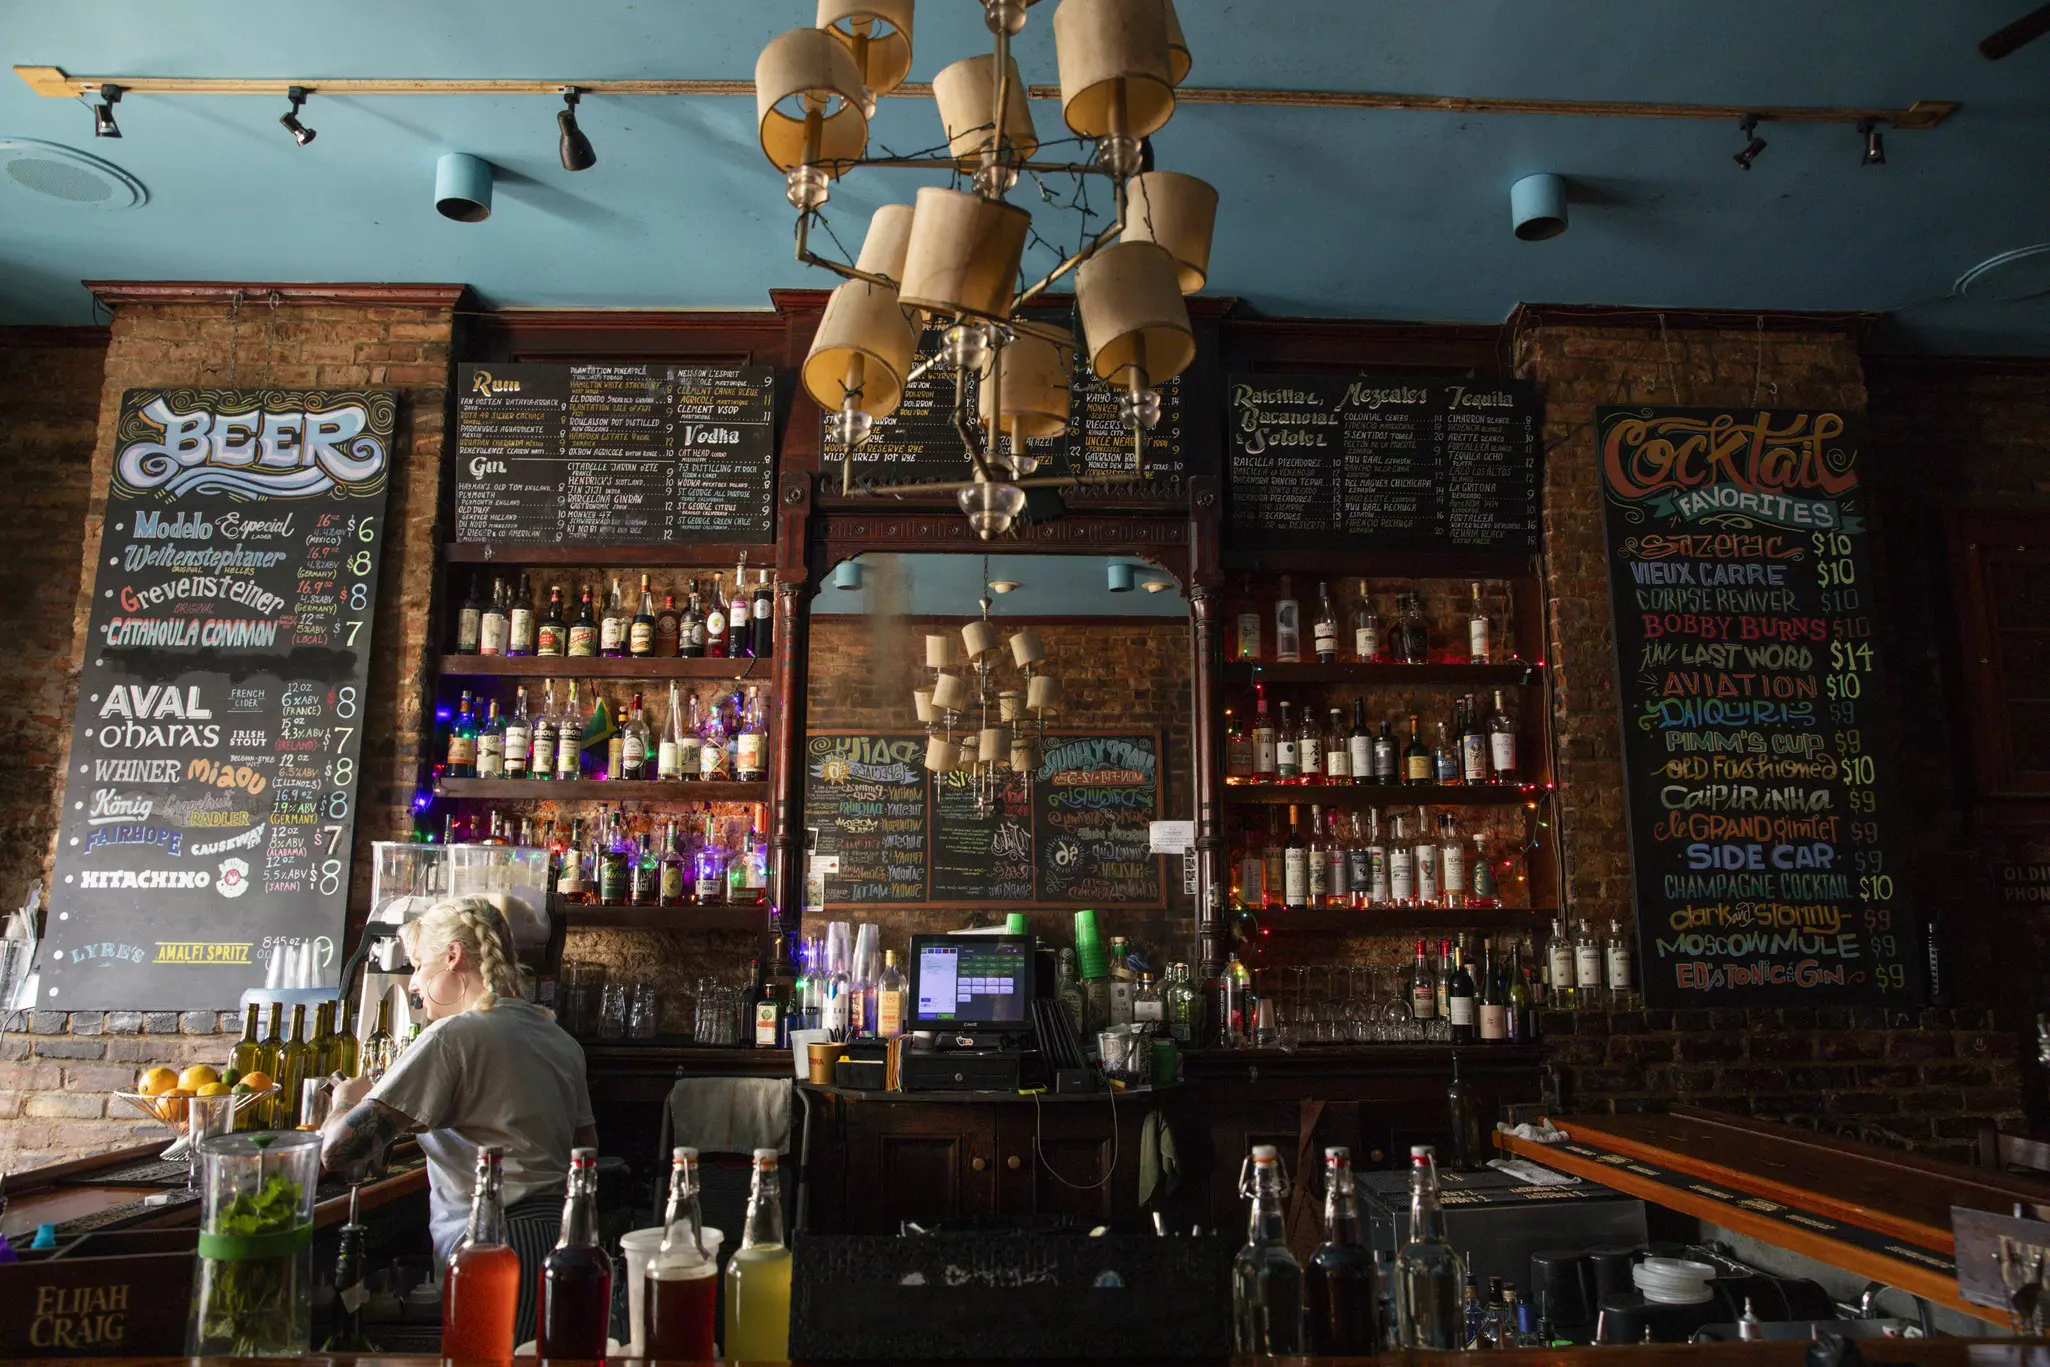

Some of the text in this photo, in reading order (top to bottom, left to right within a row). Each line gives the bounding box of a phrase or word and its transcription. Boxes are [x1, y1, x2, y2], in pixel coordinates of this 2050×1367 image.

[470, 369, 521, 398] Rum
[1333, 381, 1429, 413] Mezcales
[1444, 384, 1515, 411] Tequila
[677, 405, 716, 415] CLEMENT
[717, 406, 741, 415] VSOP
[119, 396, 386, 488] BEER
[683, 423, 742, 447] Vodka
[866, 444, 903, 454] RESERVE
[468, 456, 508, 481] Gin
[566, 462, 608, 472] CITADELLE
[1233, 456, 1274, 468] RAICILLA
[1600, 411, 1862, 500] Cocktail
[567, 476, 613, 487] HENDRICK'S
[599, 511, 613, 519] 47
[1678, 486, 1836, 529] FAVORITES
[133, 510, 213, 540] Modelo
[215, 511, 295, 544] Especial
[1812, 530, 1852, 557] $10
[124, 543, 286, 576] Weihenstephaner
[224, 566, 256, 576] HELLES
[297, 567, 337, 579] (GERMANY)
[1630, 558, 1856, 589] VIEUX CARRE $10
[120, 575, 286, 616] Grevensteiner
[294, 603, 337, 616] (GERMANY)
[1635, 587, 1861, 617] CORPSE REVIVER $10
[105, 617, 199, 646] CATAHOULA
[201, 617, 280, 648] COMMON
[1641, 613, 1733, 641] BOBBY
[1737, 615, 1829, 641] BURNS
[1680, 643, 1743, 669] LAST
[1743, 644, 1814, 672] WORD
[1829, 640, 1875, 673] $14
[1660, 671, 1862, 701] AVIATION $10
[98, 684, 213, 720] AVAL
[231, 689, 266, 698] FRENCH
[234, 698, 259, 708] CIDER
[282, 705, 321, 717] (FRANCE)
[229, 739, 267, 747] STOUT
[231, 730, 265, 740] IRISH
[1664, 730, 1768, 754] PIMM'S
[95, 758, 181, 784] WHINER
[186, 758, 267, 796] Miaou
[1839, 754, 1877, 786] $10
[90, 787, 155, 824] König
[190, 811, 250, 827] RADLER
[269, 812, 318, 825] (GERMANY)
[83, 826, 184, 857] FAIRHOPE
[190, 822, 266, 857] CAUSEWAY
[1687, 812, 1774, 842] GRAND
[1685, 842, 1768, 871] SIDE
[1769, 842, 1836, 870] CAR
[80, 869, 211, 889] HITACHINO
[265, 881, 301, 893] (JAPAN)
[1663, 872, 1894, 903] CHAMPAGNE COCKTAIL $10
[69, 941, 147, 965] LYRE'S
[158, 944, 205, 962] AMALFI
[206, 944, 249, 962] SPRITZ
[1655, 930, 1770, 958] MOSCOW
[1768, 927, 1861, 959] MULE
[35, 1284, 131, 1316] ELIJAH
[29, 1314, 126, 1349] CRAIG
